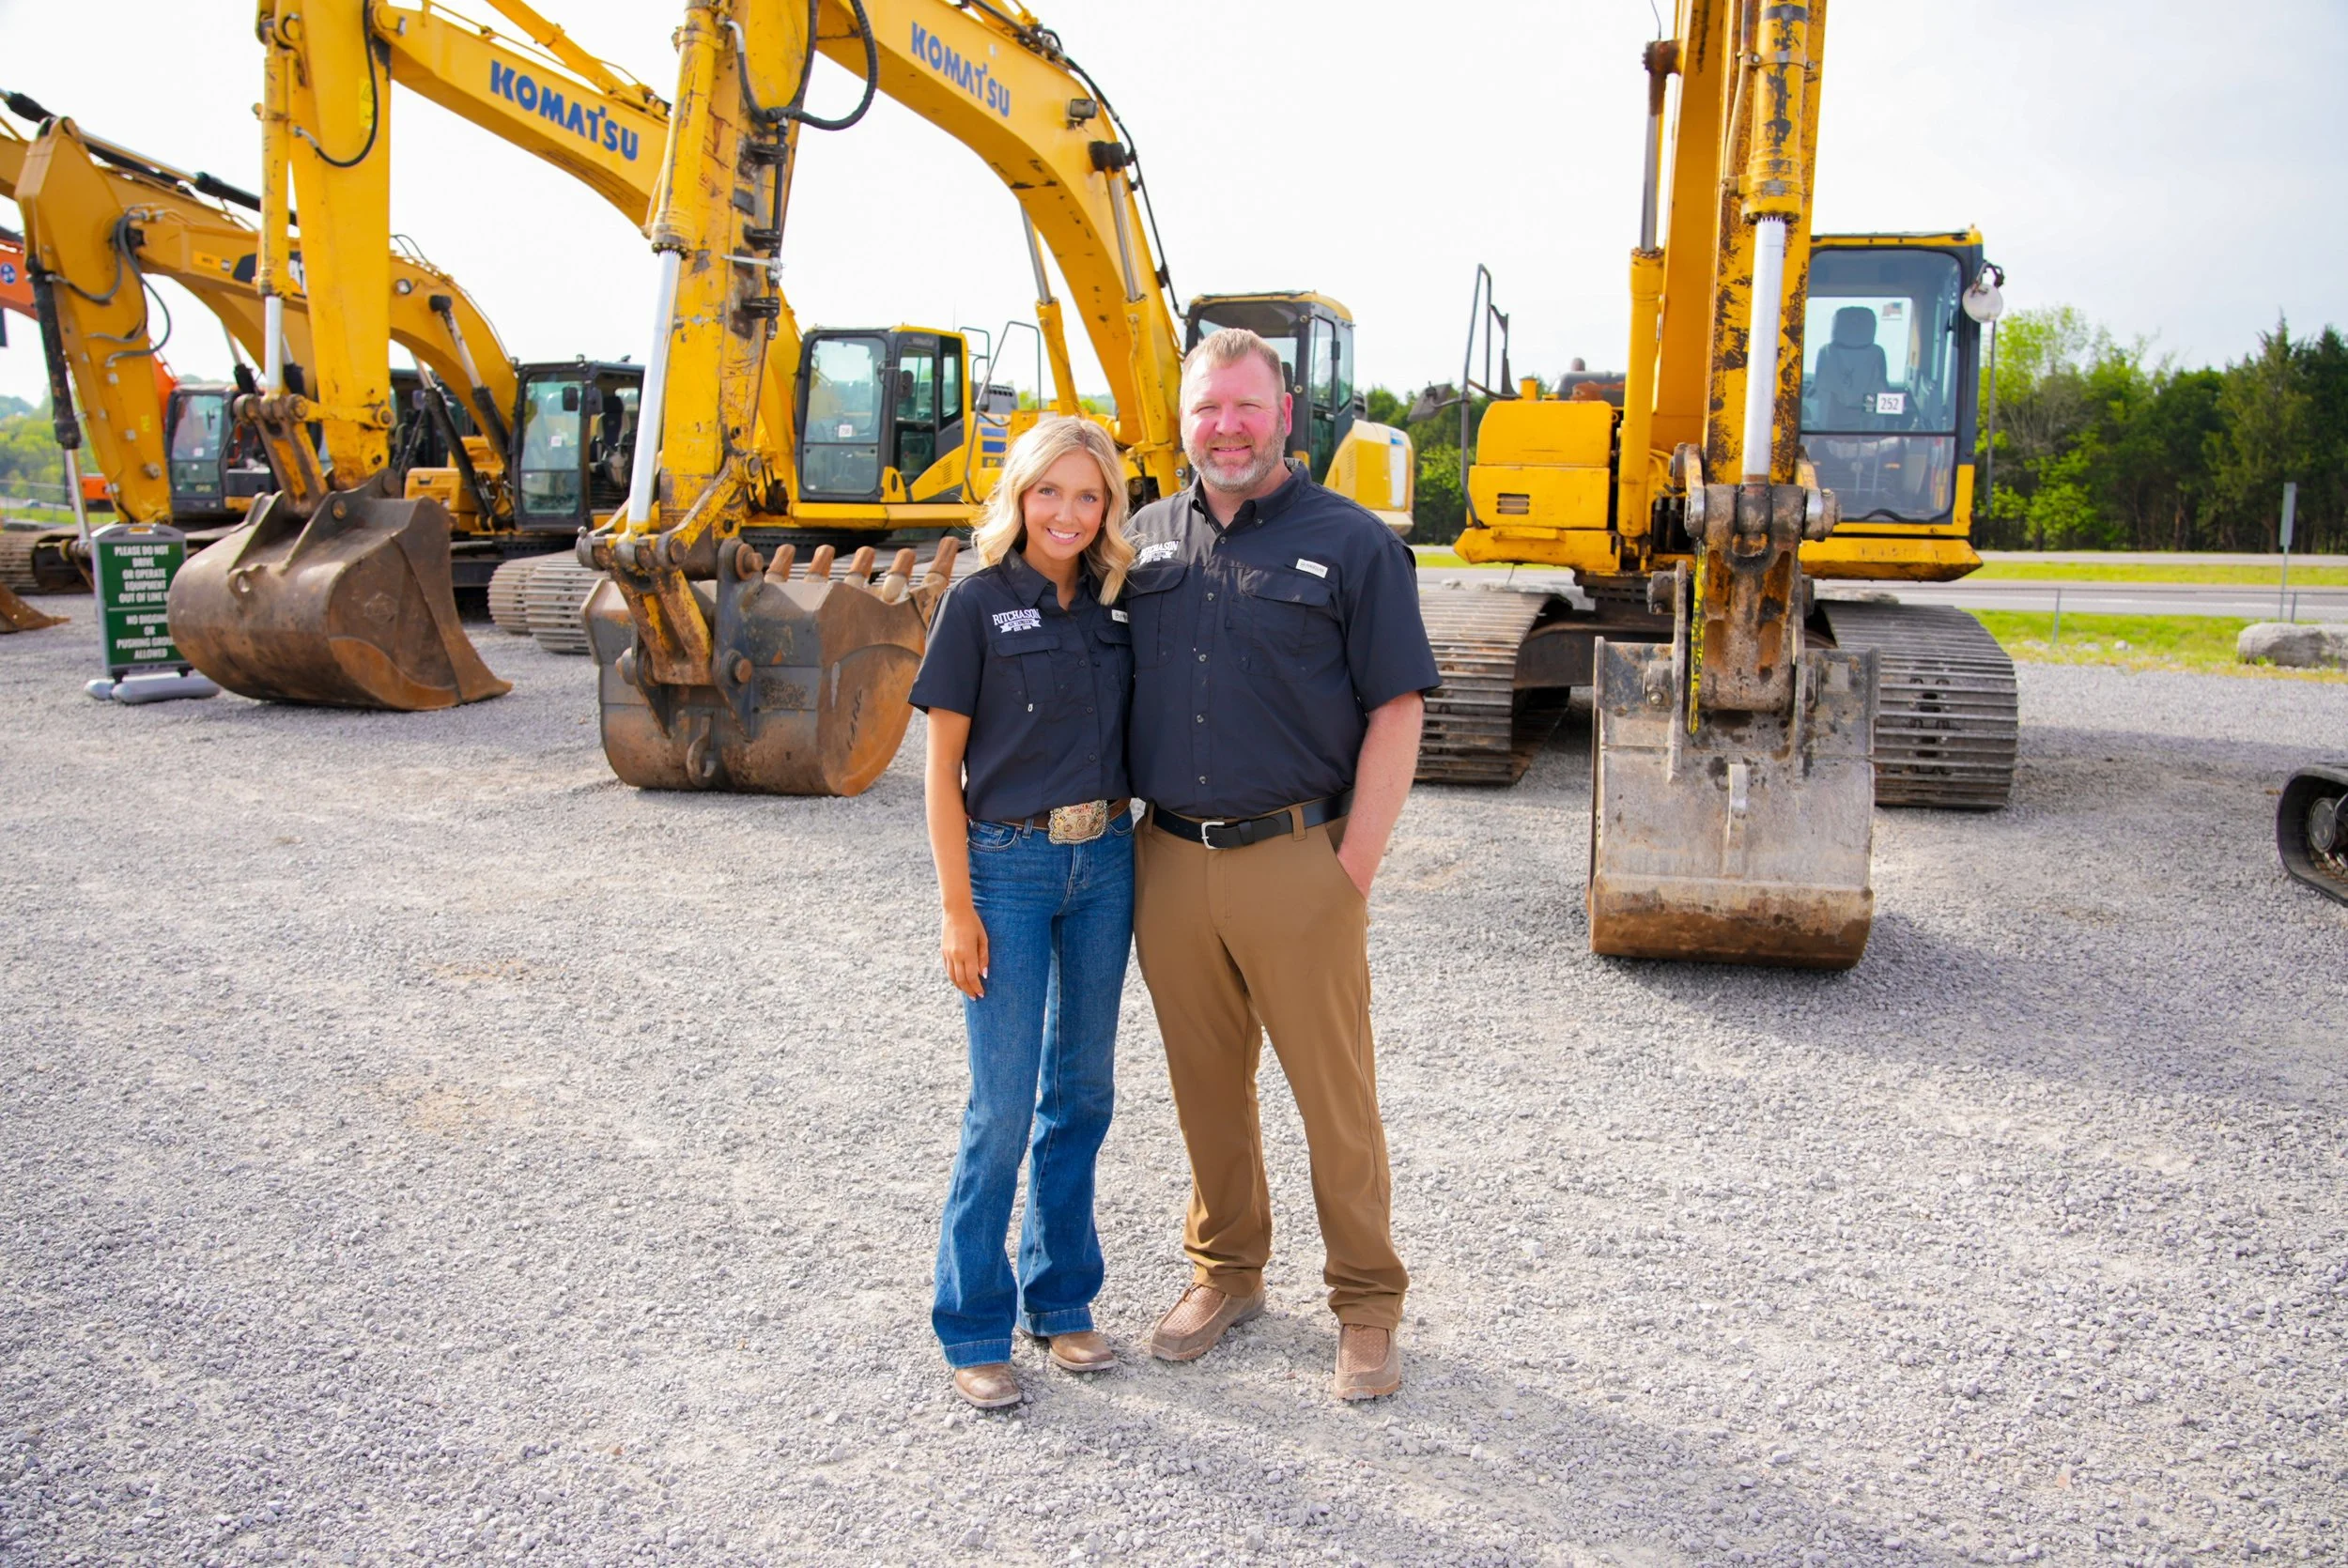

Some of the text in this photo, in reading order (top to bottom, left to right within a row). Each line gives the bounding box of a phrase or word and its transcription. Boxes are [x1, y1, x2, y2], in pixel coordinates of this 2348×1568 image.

[911, 21, 1010, 118] KOMATSU
[490, 59, 638, 161] KOMATSU
[1880, 397, 1899, 410] 252
[114, 545, 169, 556] PLEASE DO NOT
[122, 568, 166, 579] OR OPERATE
[124, 579, 166, 592] EQUIPMENT
[118, 592, 135, 603] OUT
[136, 592, 146, 603] OF
[126, 615, 138, 625] NO
[992, 608, 1042, 625] RITCHASON
[144, 625, 156, 636] OR
[116, 638, 150, 649] PUSHING
[133, 648, 168, 659] ALLOWED
